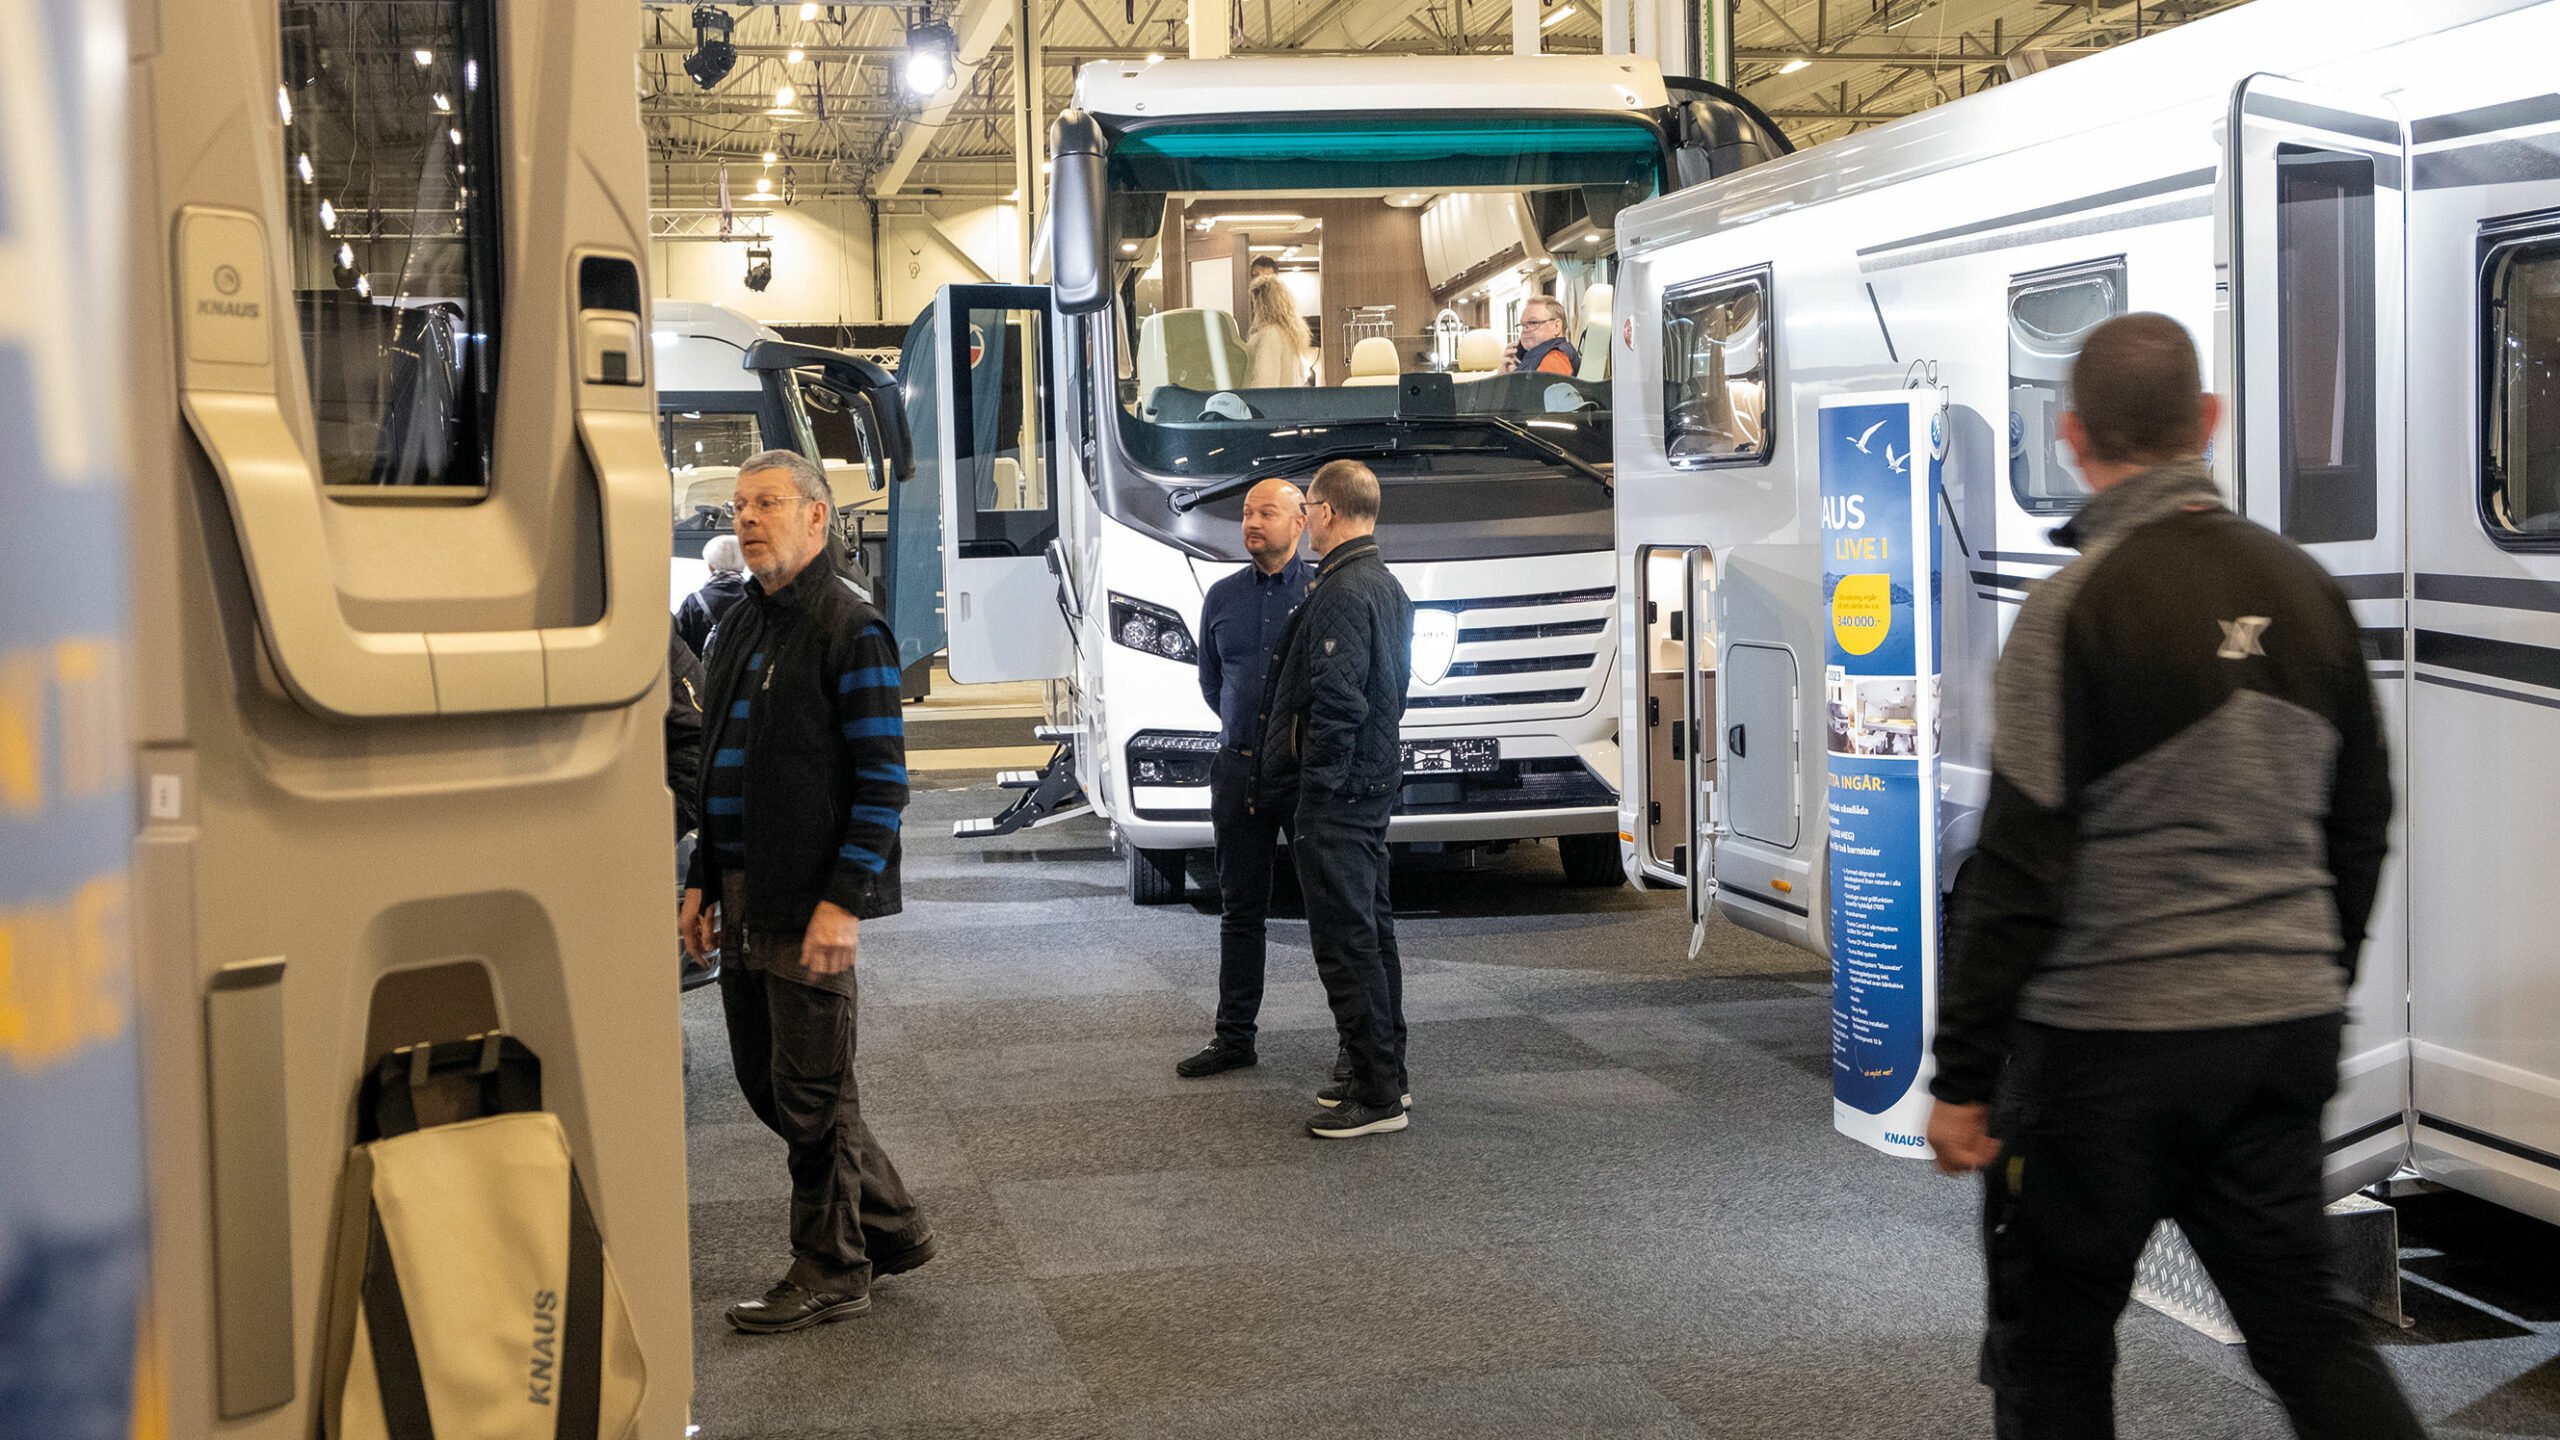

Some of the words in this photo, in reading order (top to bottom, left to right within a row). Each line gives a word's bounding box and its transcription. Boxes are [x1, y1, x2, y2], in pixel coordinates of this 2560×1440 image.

[197, 301, 258, 317] KNAUS
[1836, 537, 1877, 560] LIVE
[1837, 615, 1853, 627] 340
[1841, 774, 1886, 791] INGÅR:
[1846, 843, 1881, 857] barnstolar
[1884, 1131, 1925, 1147] KNAUS
[527, 1289, 558, 1406] KNAUS
